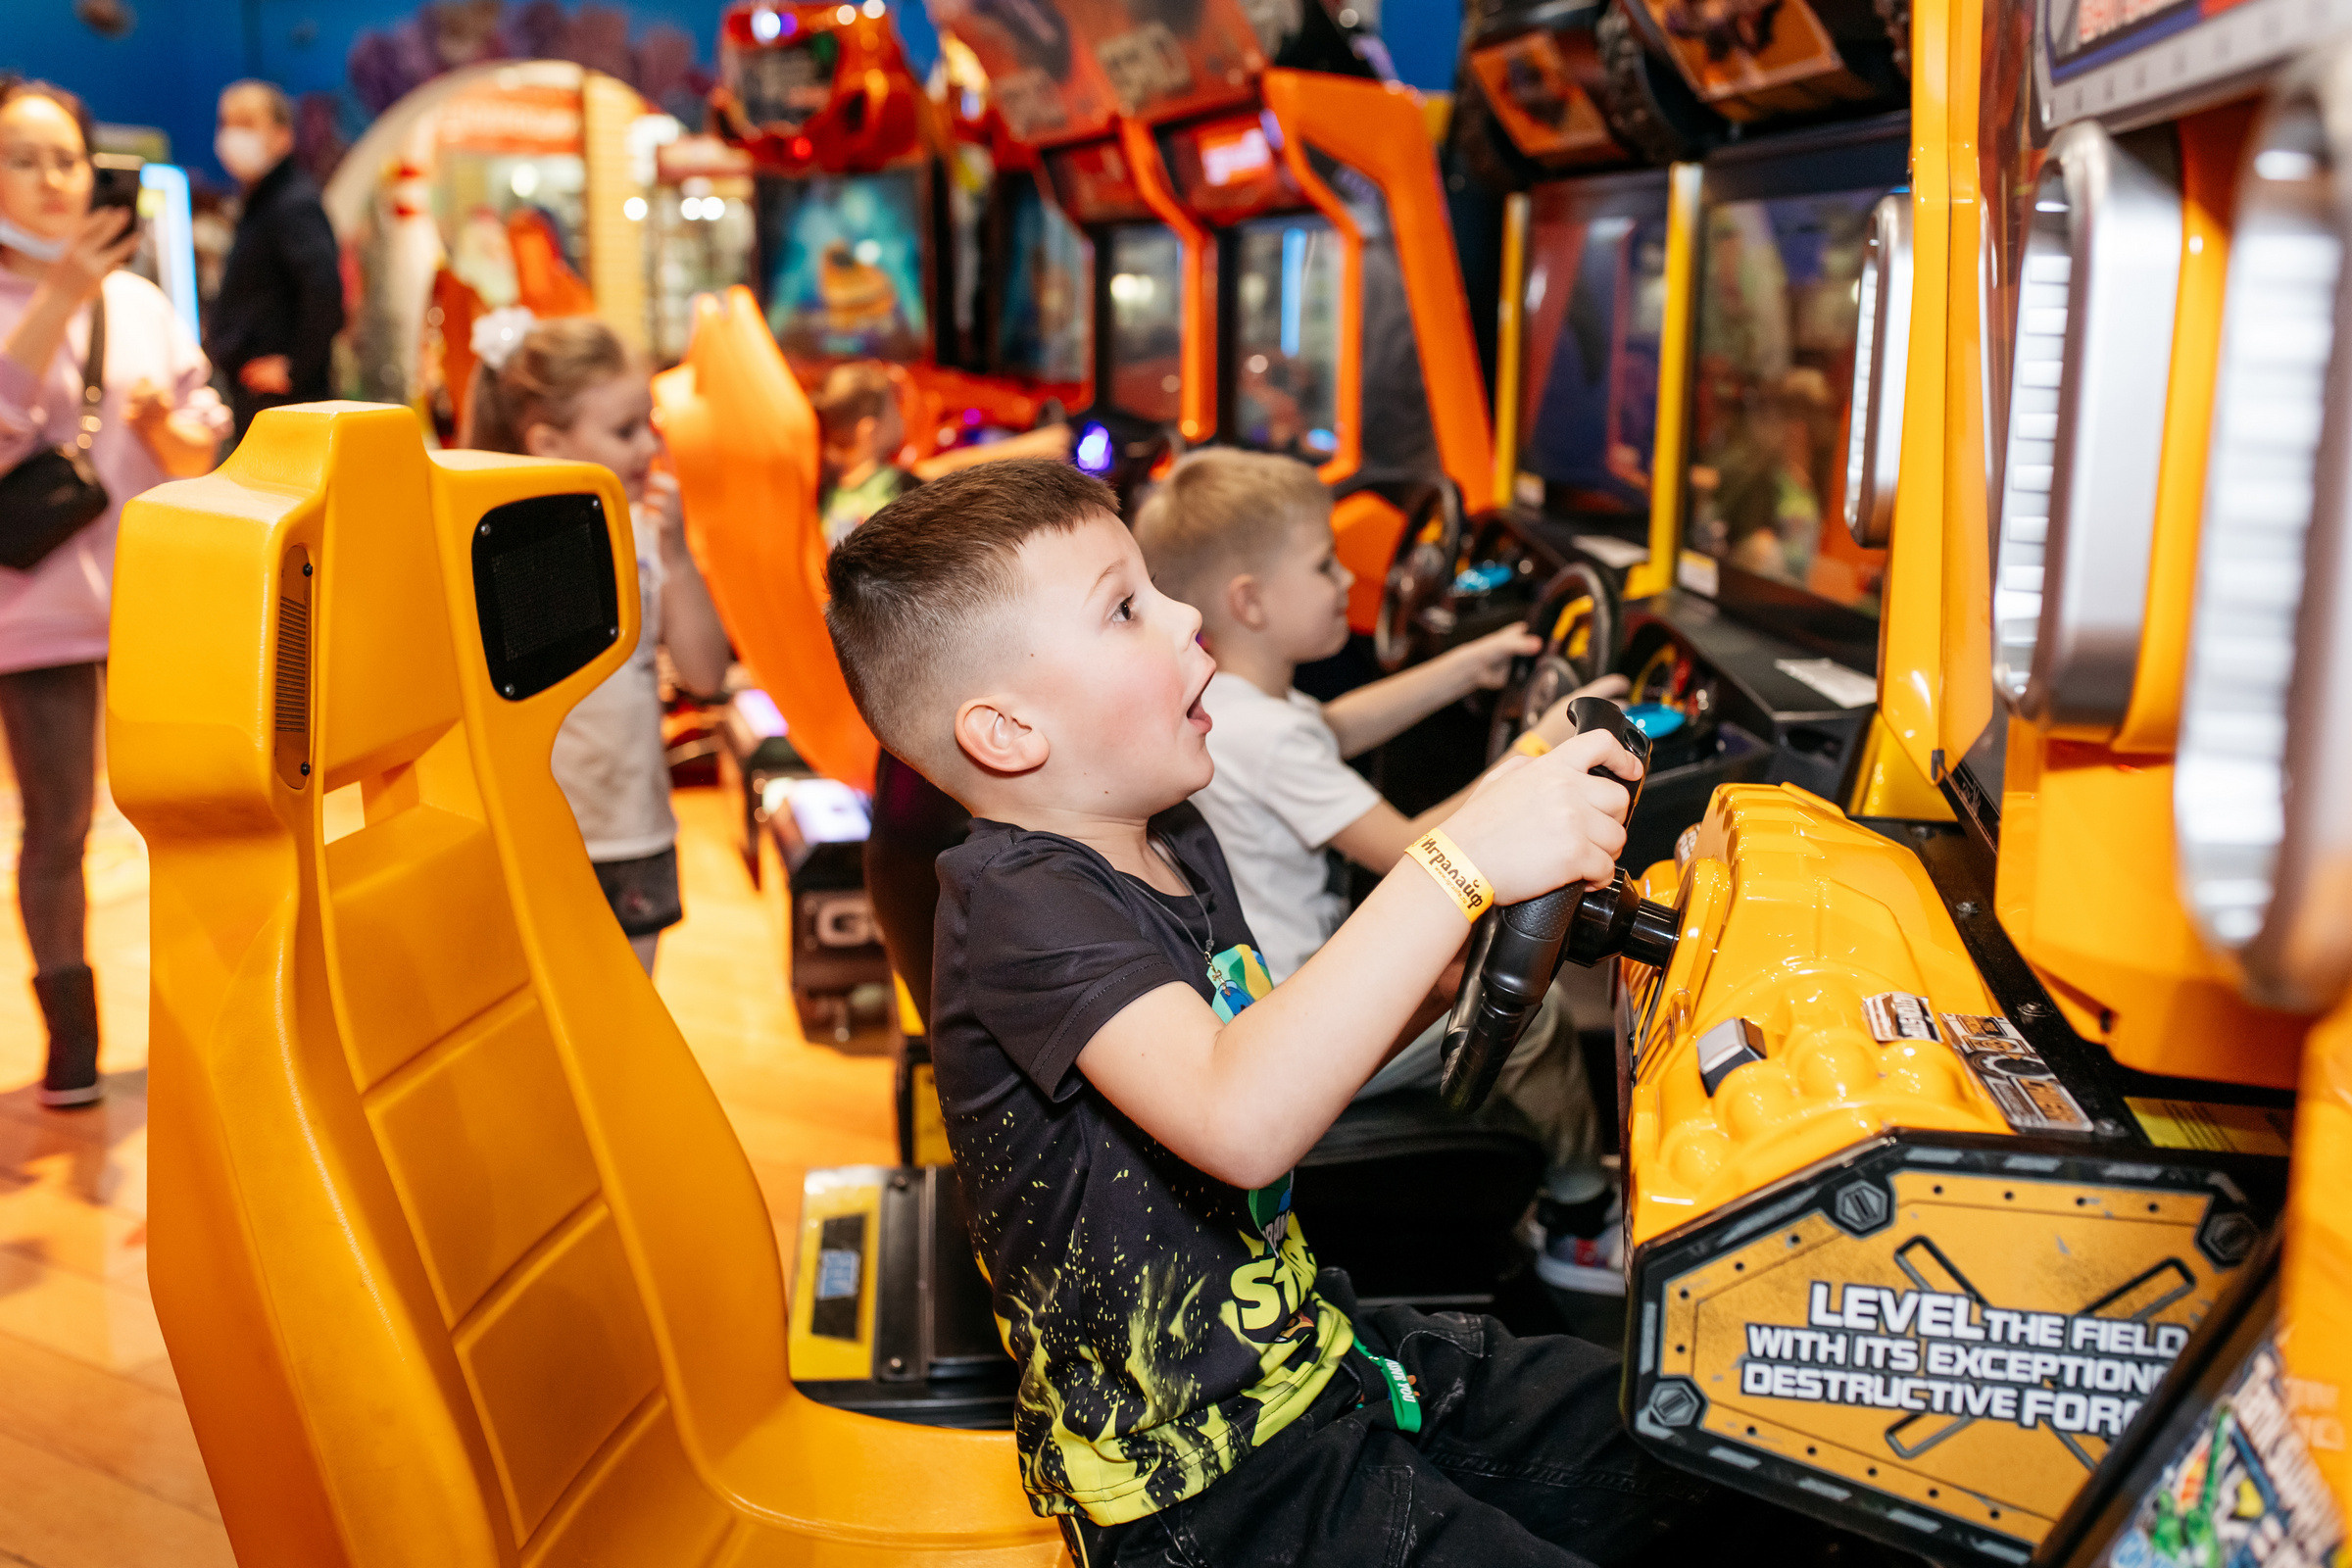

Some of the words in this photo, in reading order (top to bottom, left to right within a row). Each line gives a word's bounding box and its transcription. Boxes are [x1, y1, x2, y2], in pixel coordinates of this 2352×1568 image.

[1420, 837, 1484, 909] Игралайф
[1747, 1325, 1847, 1366] WITH
[1853, 1335, 1920, 1372] ITS
[1810, 1283, 1985, 1341] LEVEL
[1983, 1309, 2066, 1348] THE
[2071, 1316, 2190, 1359] FIELD
[1397, 1382, 1417, 1403] YOU
[1743, 1362, 2019, 1420] DESTRUCTIVE
